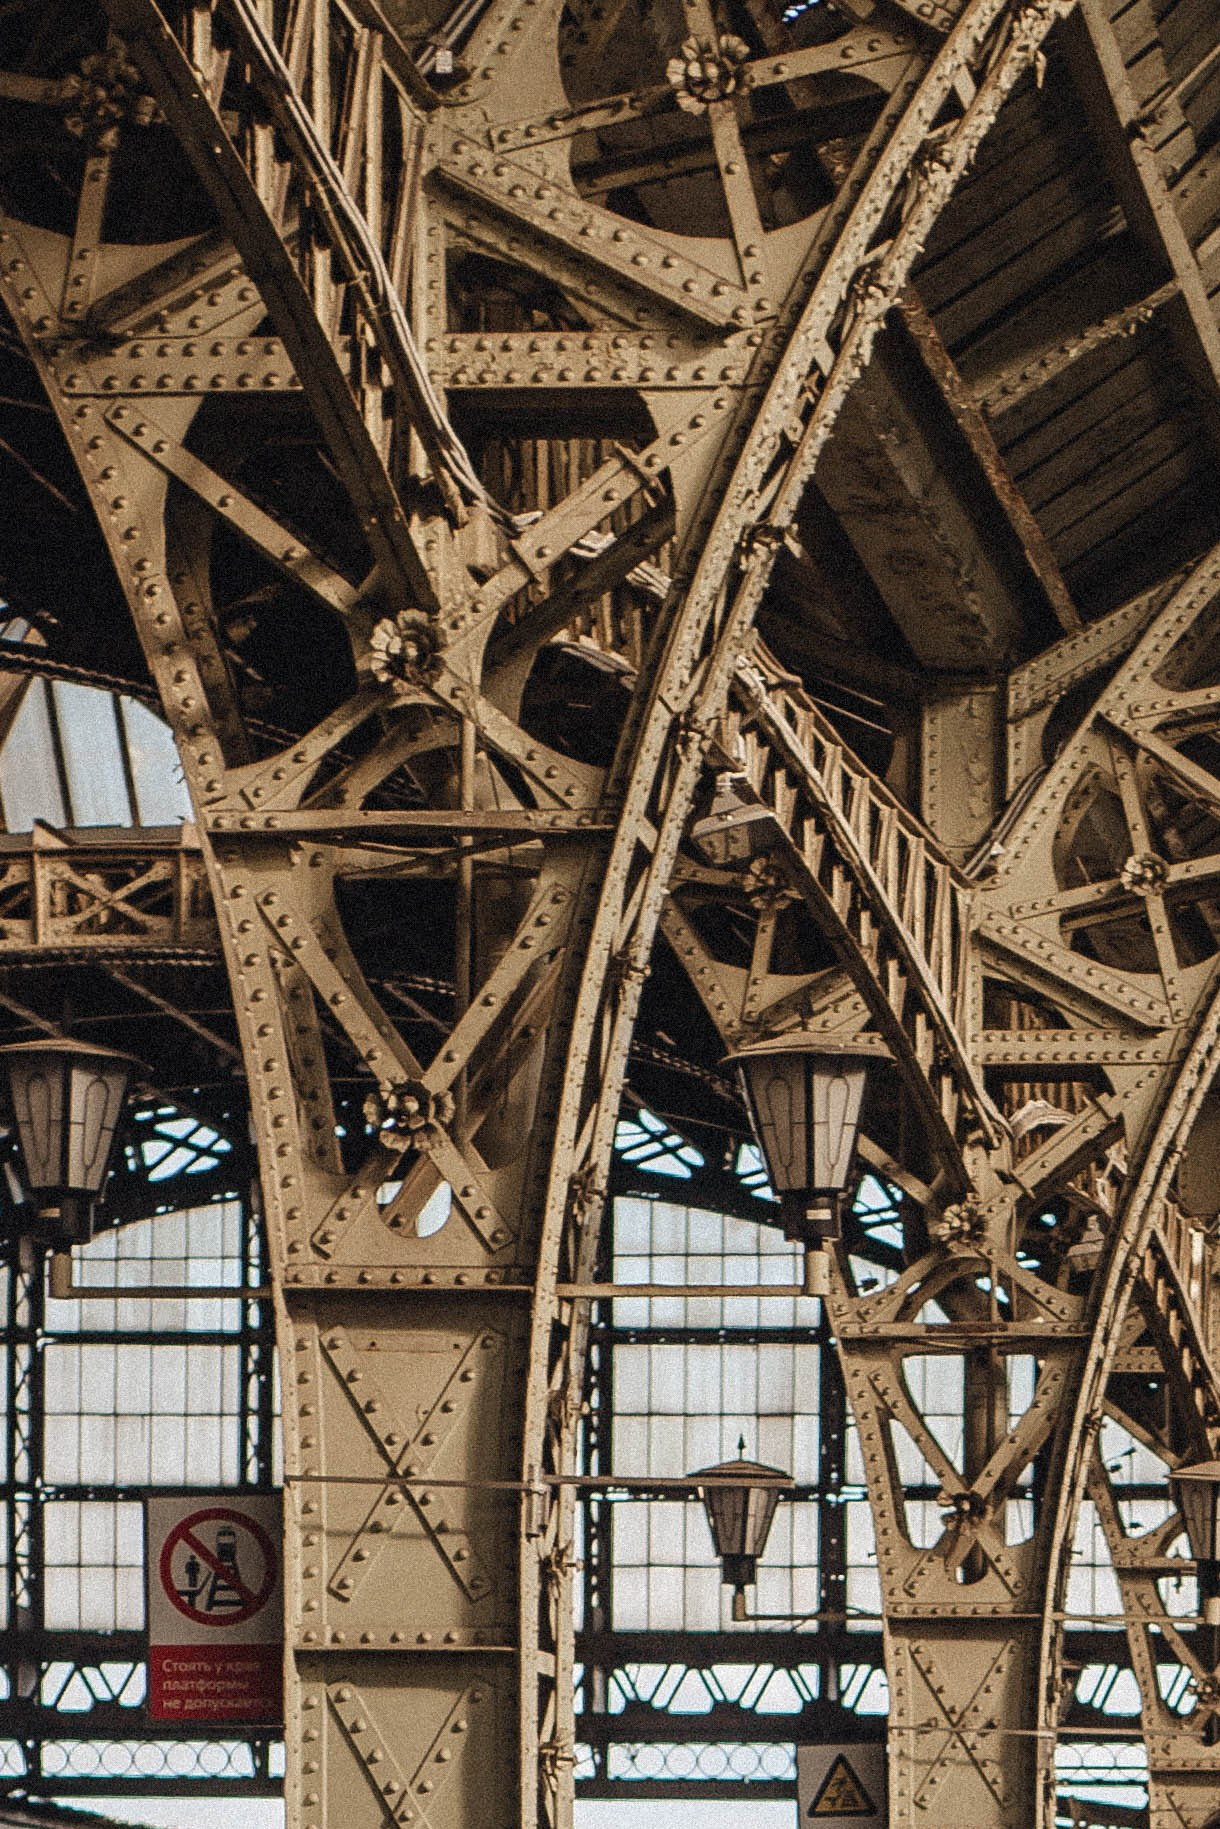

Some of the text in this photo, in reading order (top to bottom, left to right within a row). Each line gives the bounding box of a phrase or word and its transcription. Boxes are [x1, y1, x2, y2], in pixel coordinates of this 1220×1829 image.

[161, 1659, 213, 1674] Стоять
[214, 1663, 223, 1676] у
[162, 1678, 250, 1693] платформы
[162, 1699, 182, 1711] не
